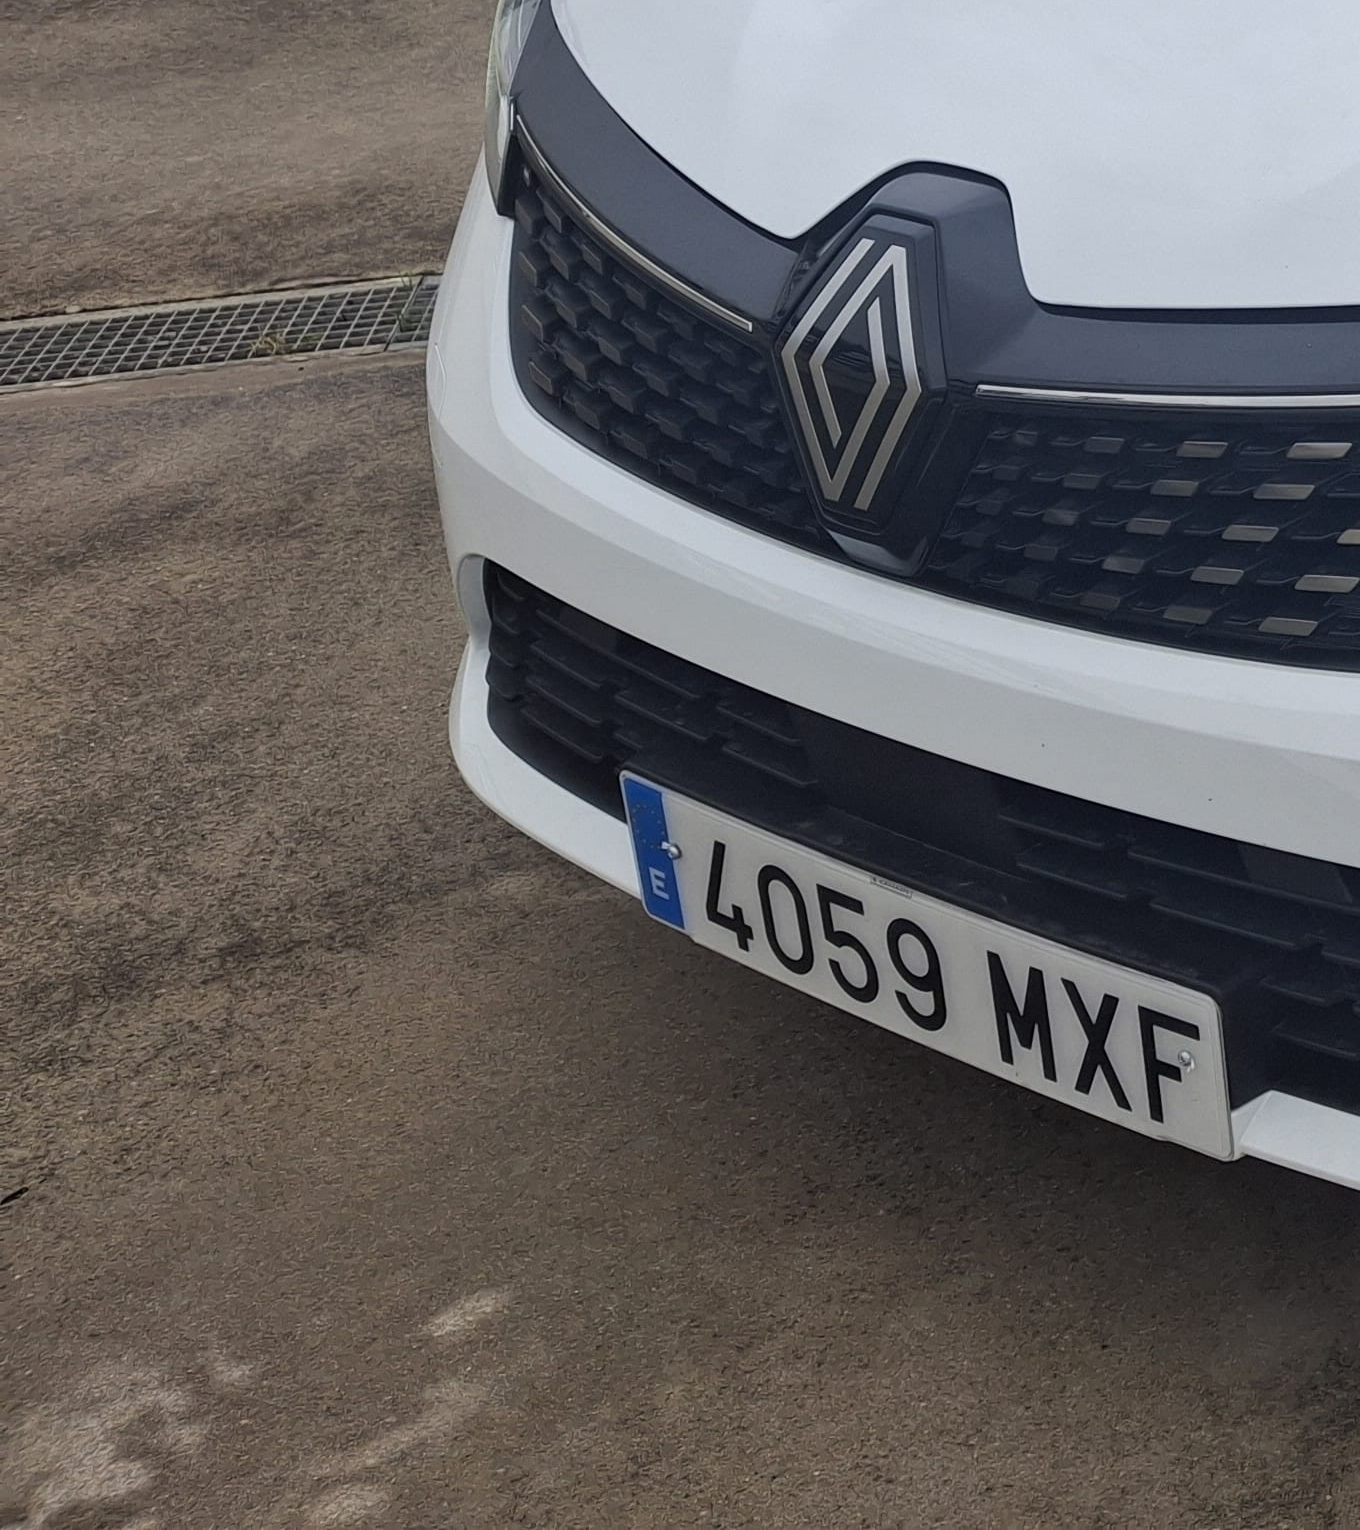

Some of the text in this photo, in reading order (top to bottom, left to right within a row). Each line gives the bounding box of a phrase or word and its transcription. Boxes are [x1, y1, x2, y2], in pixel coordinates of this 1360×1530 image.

[649, 840, 1200, 1123] E 4059 MXF
